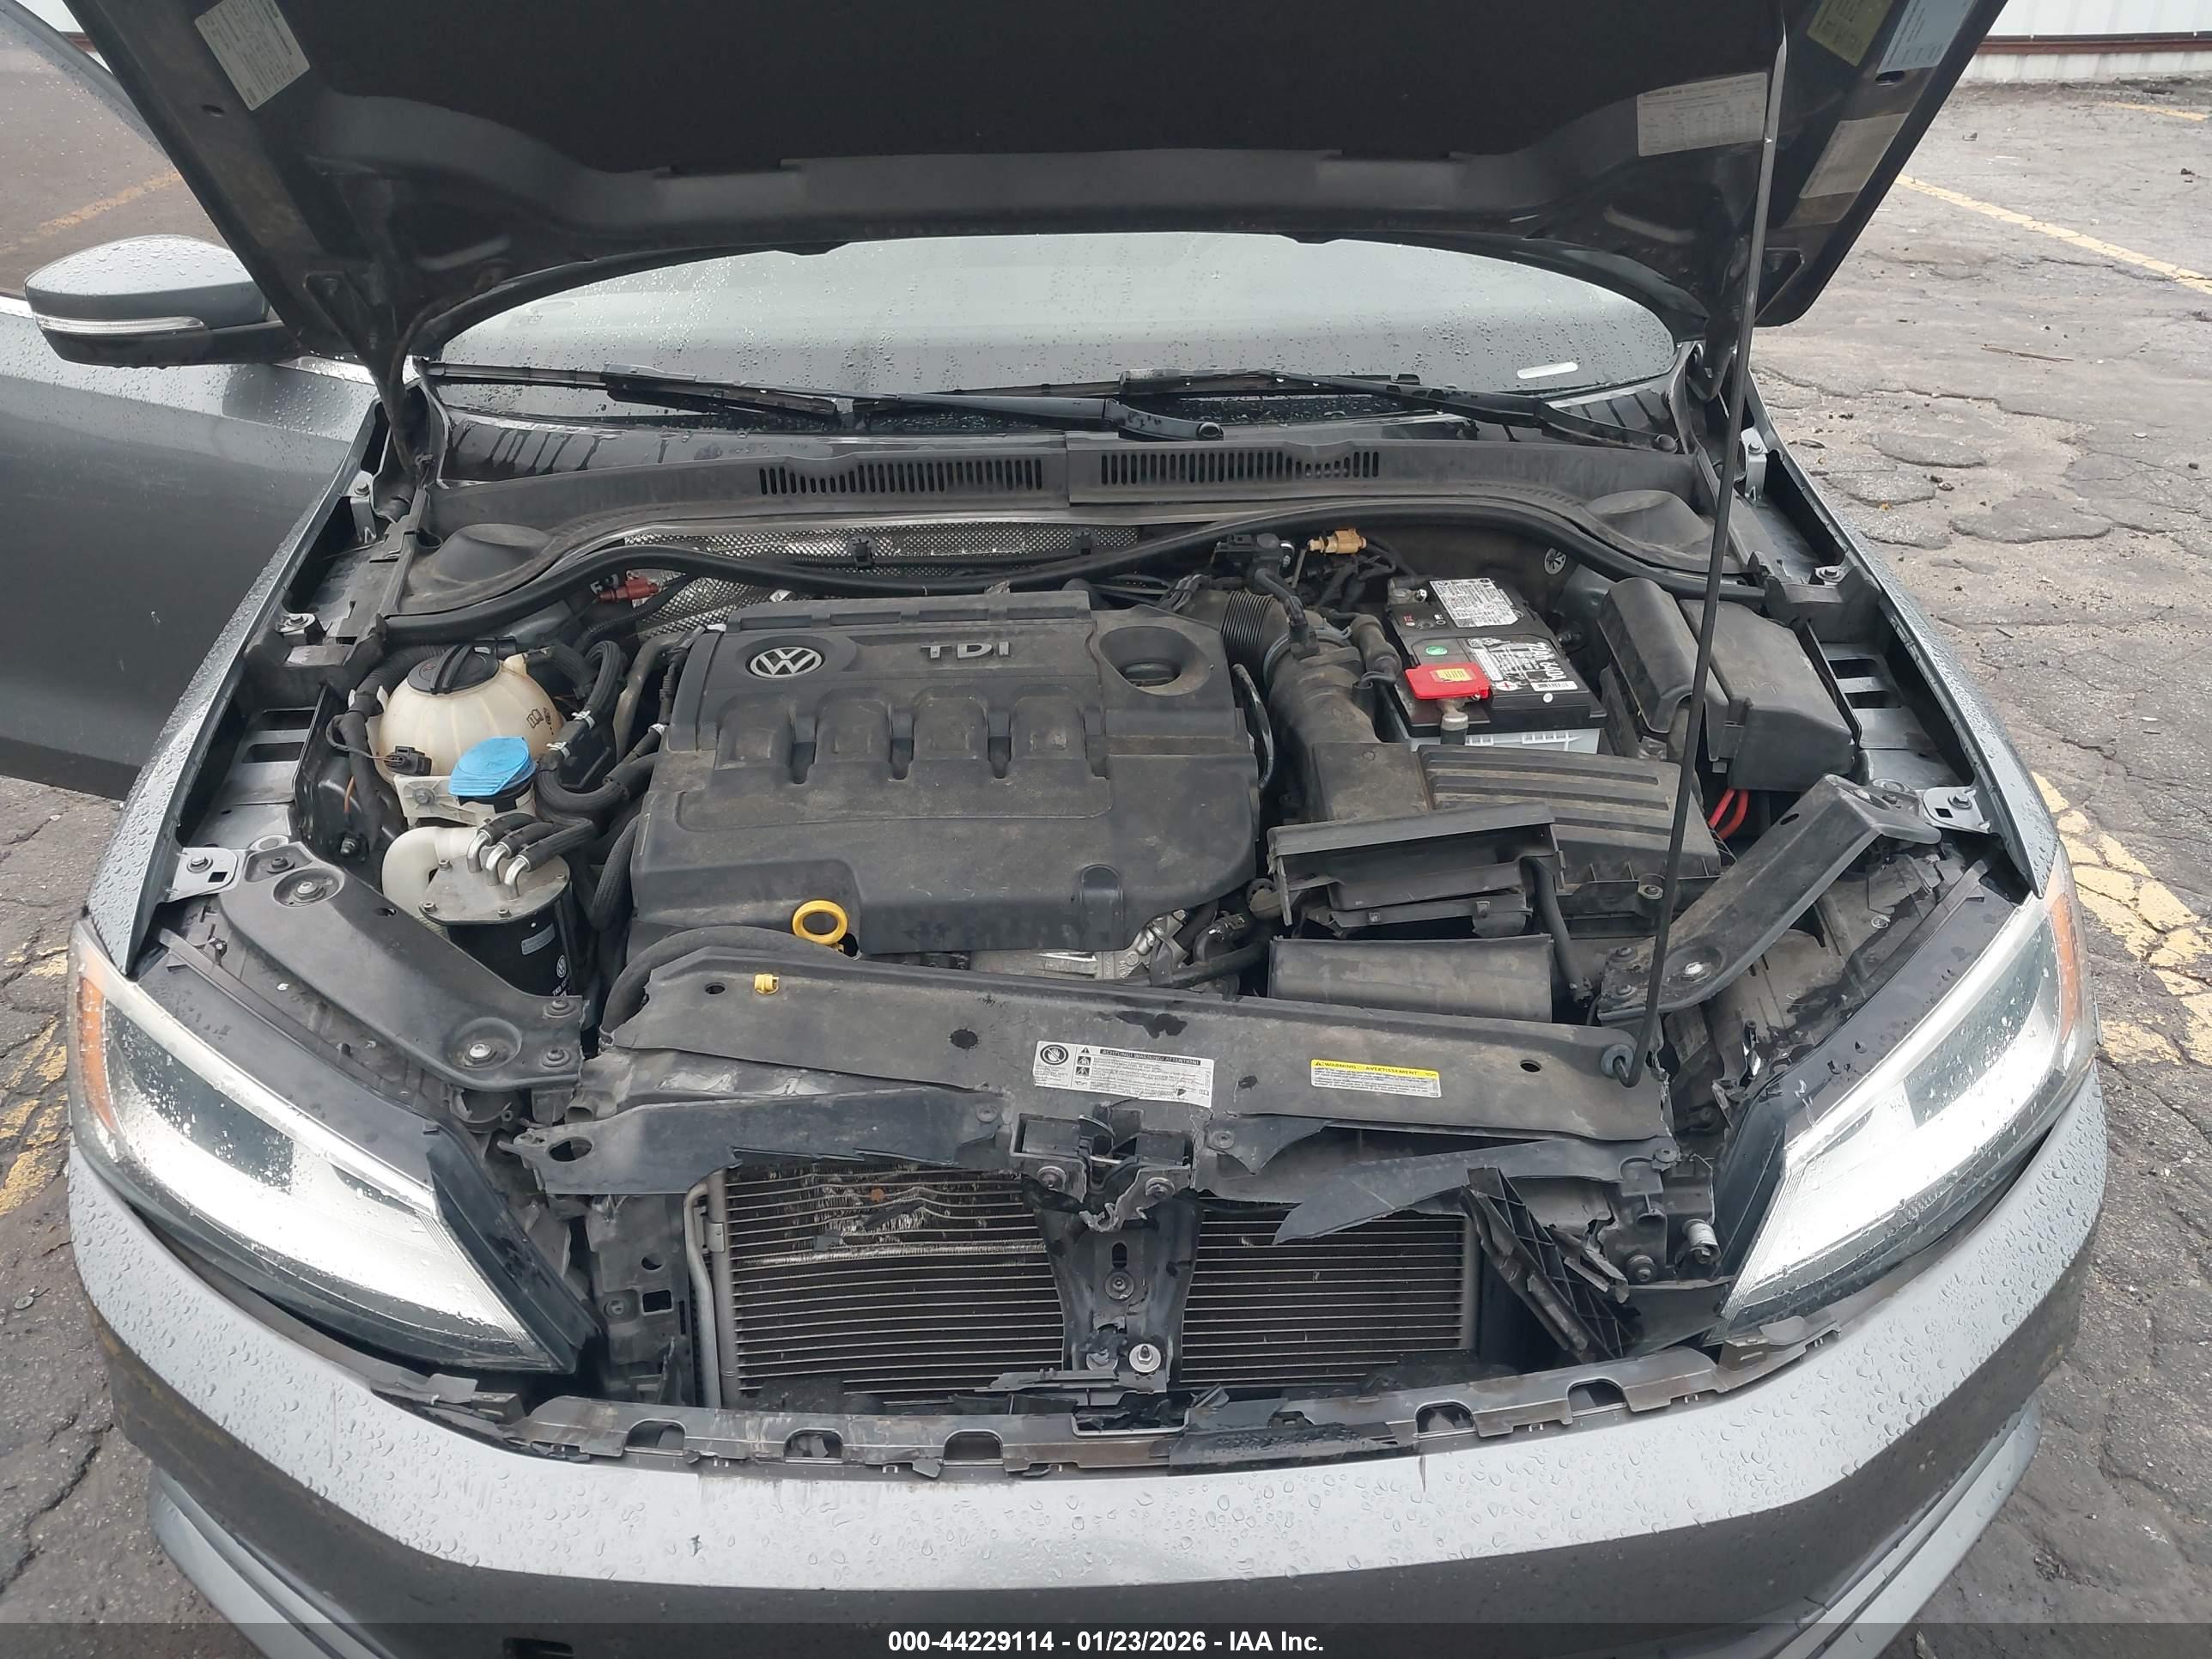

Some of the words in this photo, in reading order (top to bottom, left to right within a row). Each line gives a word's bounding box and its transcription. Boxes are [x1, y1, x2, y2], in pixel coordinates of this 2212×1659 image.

[920, 641, 1012, 659] TDI
[749, 646, 823, 679] VW
[1365, 1066, 1418, 1075] AVERTISSEMENT
